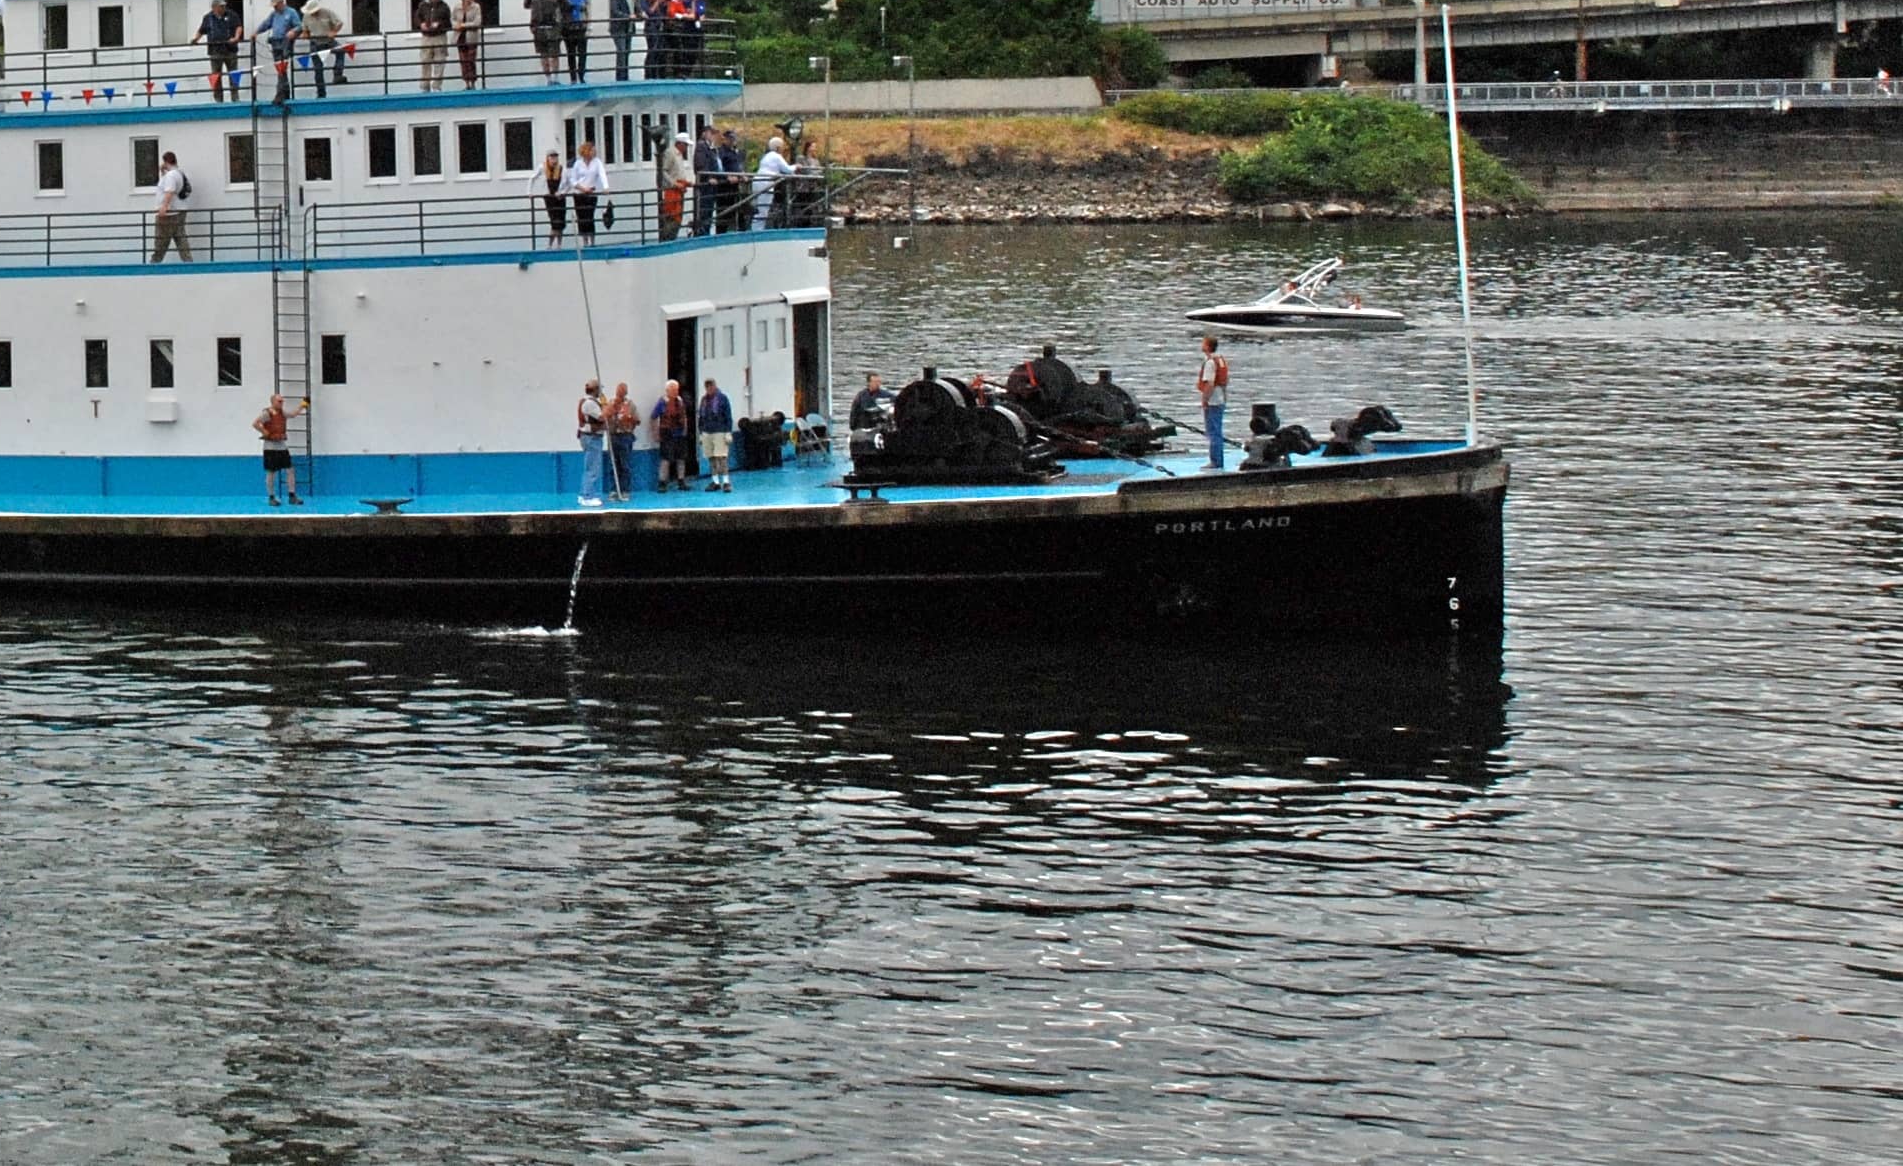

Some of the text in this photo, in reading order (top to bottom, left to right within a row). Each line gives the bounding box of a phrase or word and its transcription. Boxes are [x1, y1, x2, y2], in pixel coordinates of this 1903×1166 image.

[1154, 516, 1291, 534] PORTLAND
[1446, 576, 1457, 589] 7
[1448, 597, 1460, 610] 6
[1450, 618, 1460, 630] 5
